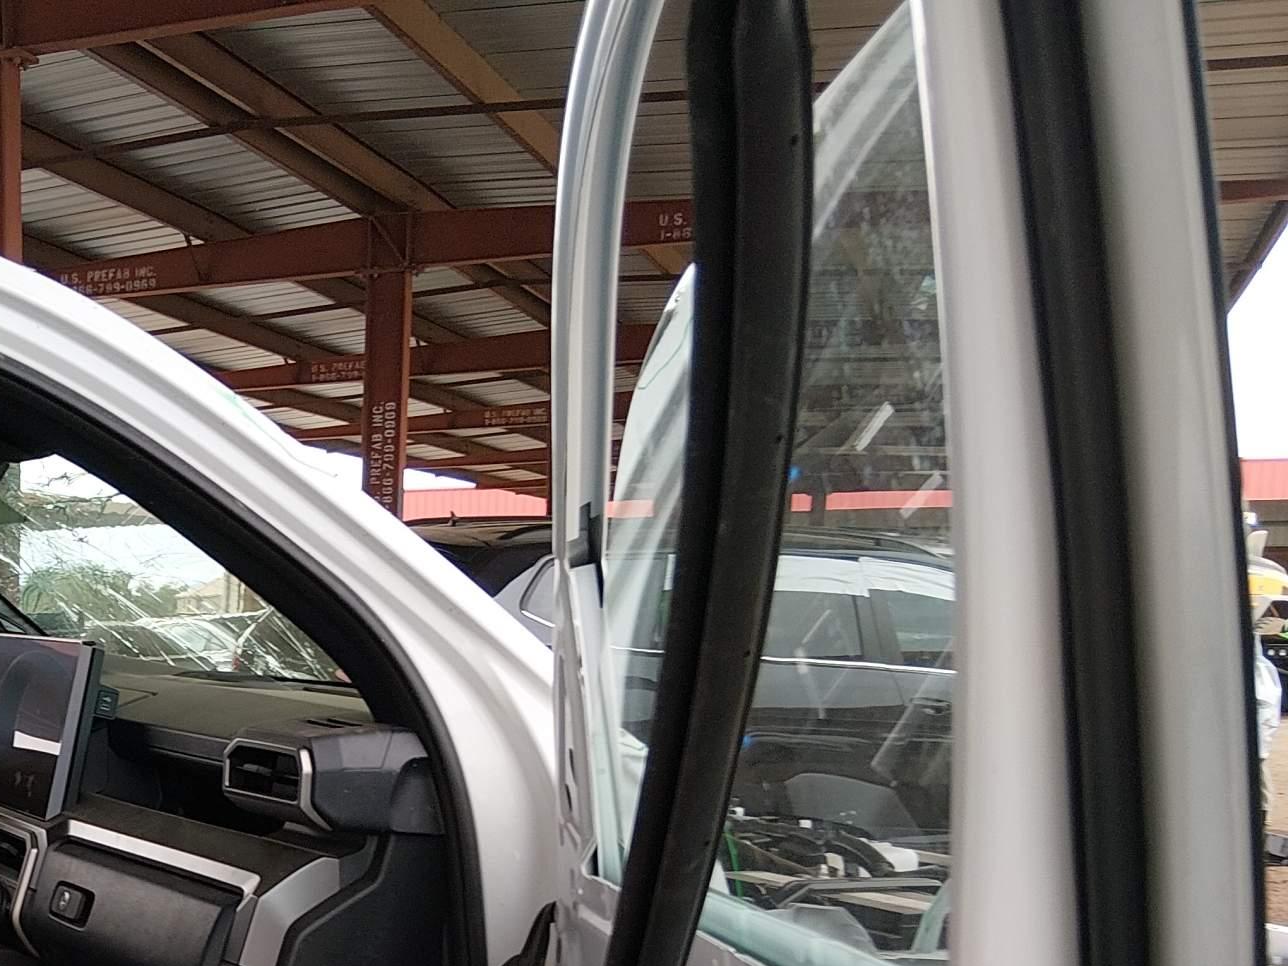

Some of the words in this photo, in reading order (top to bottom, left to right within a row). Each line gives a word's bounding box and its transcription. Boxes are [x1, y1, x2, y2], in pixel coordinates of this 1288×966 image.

[87, 267, 130, 282] PREFAB
[372, 401, 384, 427] INC.
[370, 433, 383, 485] PREFAB
[381, 401, 397, 509] -866-799-0969
